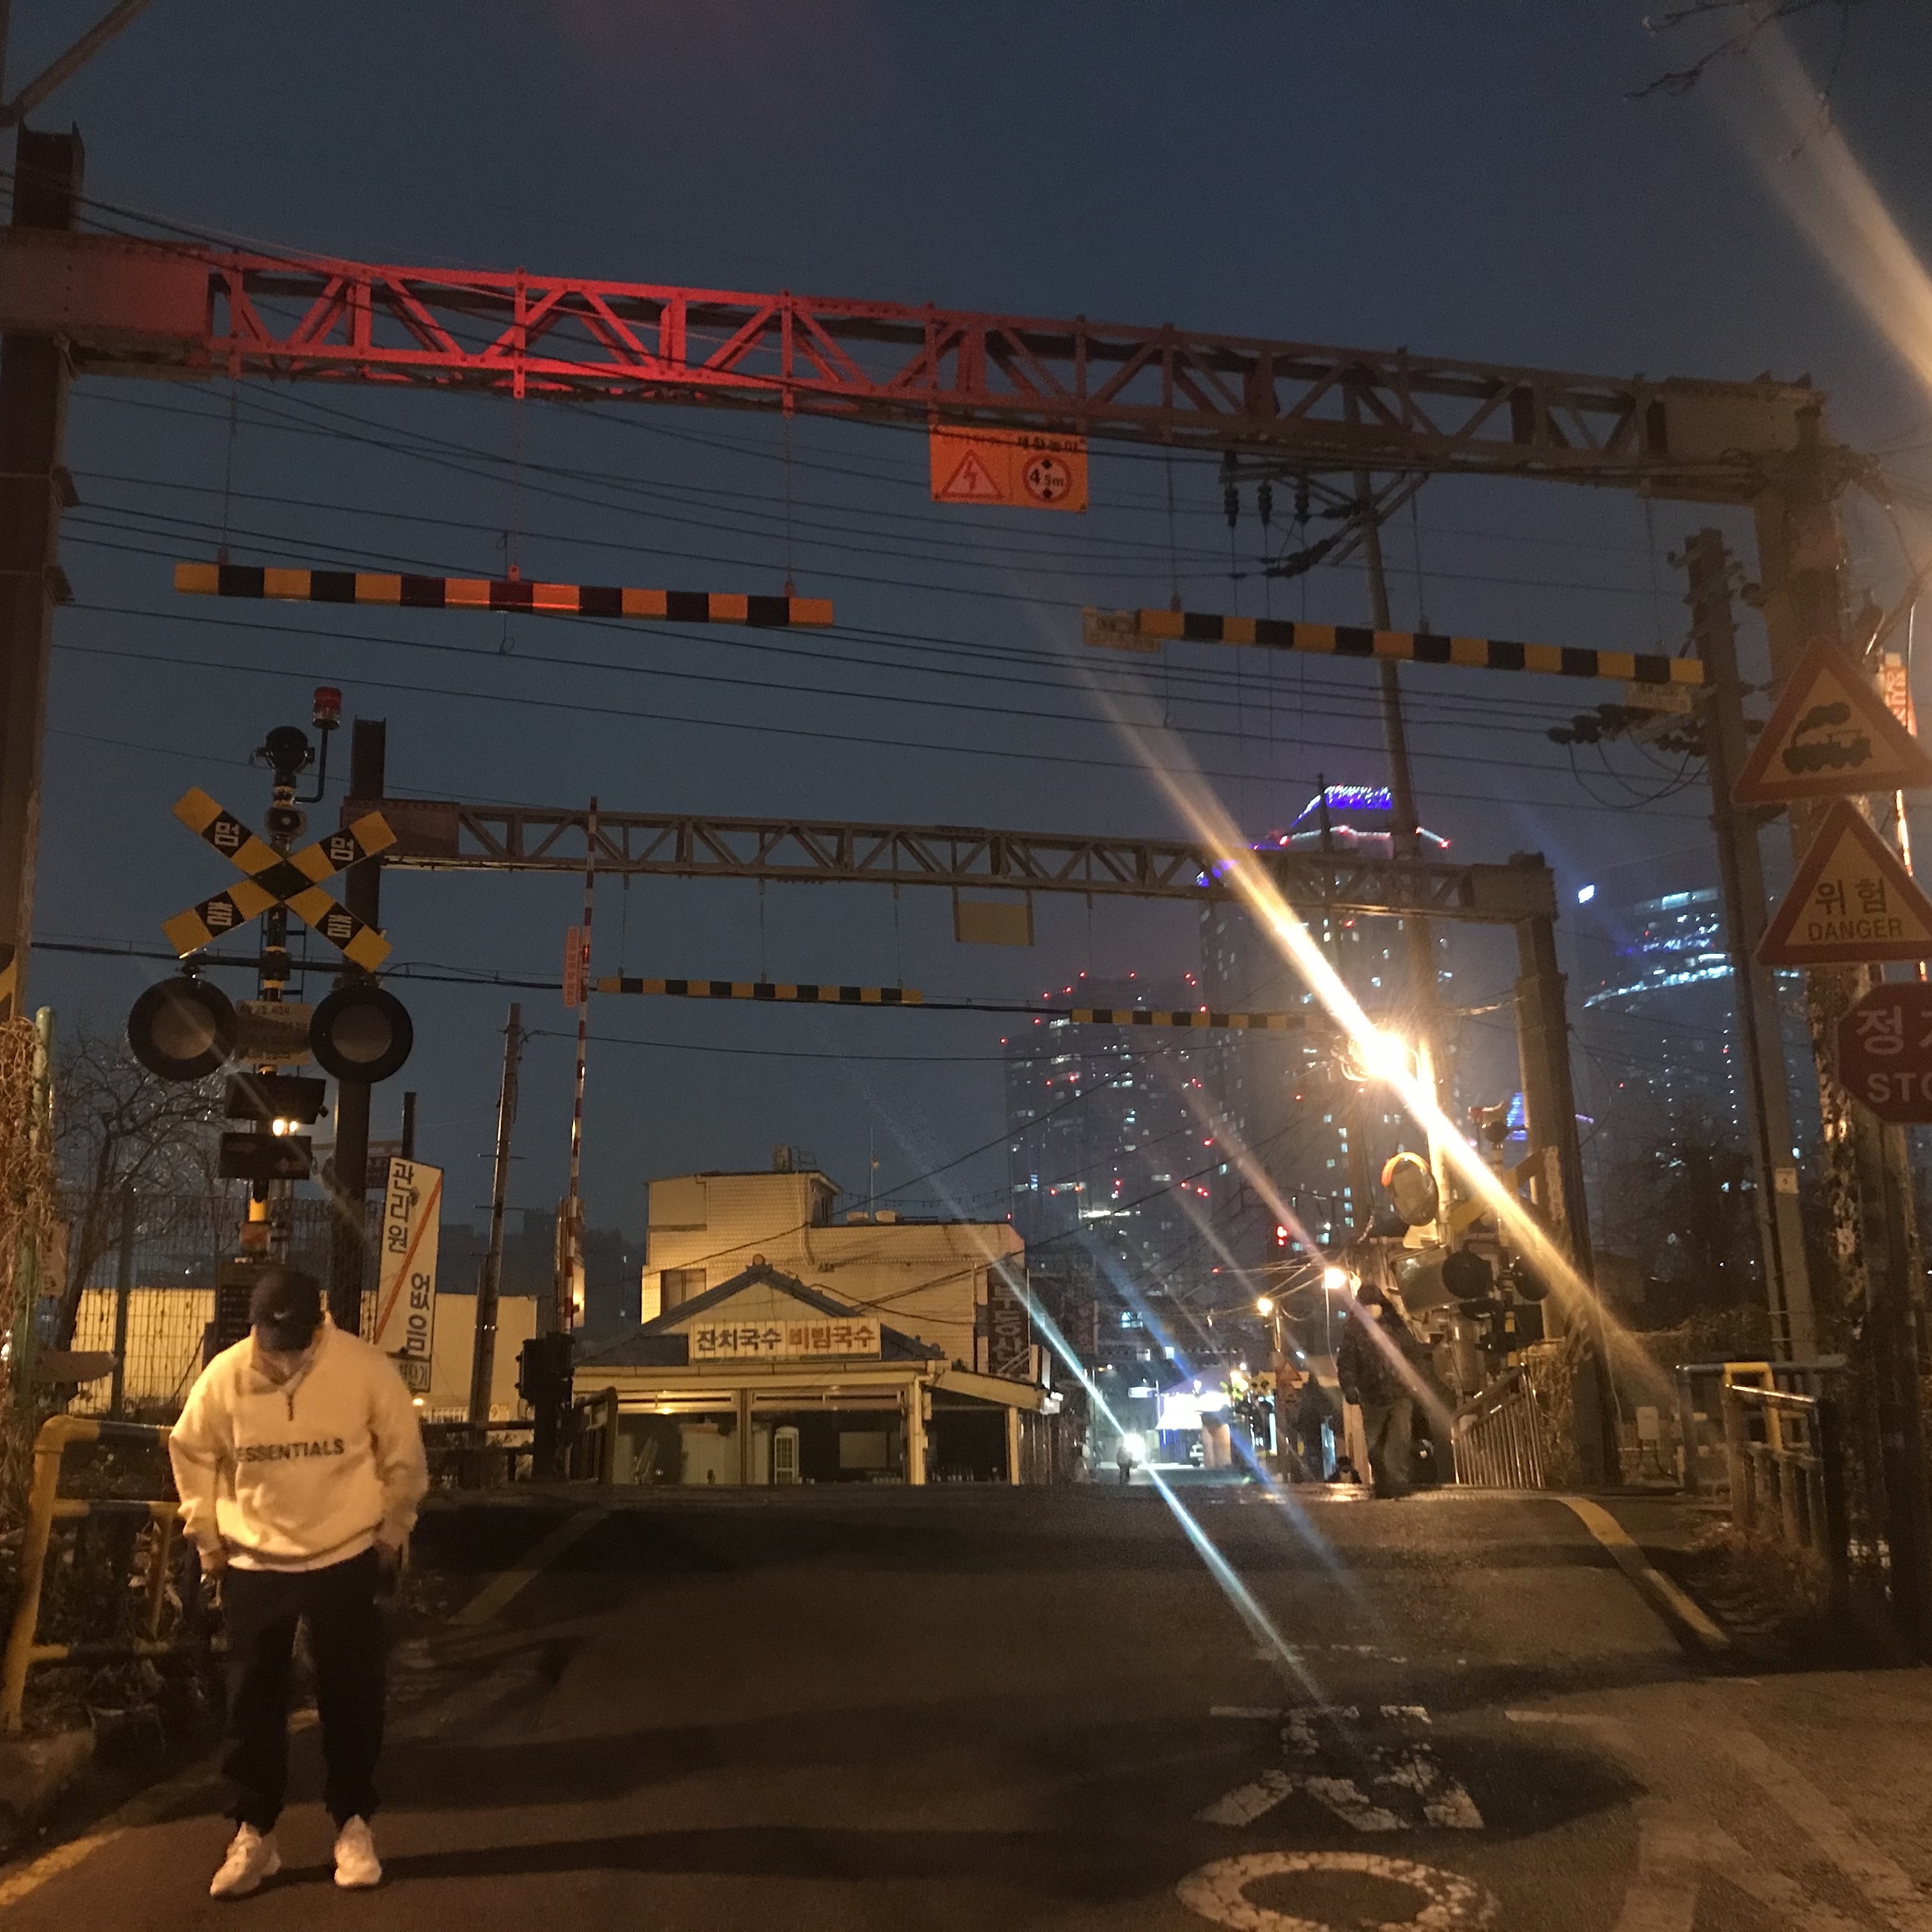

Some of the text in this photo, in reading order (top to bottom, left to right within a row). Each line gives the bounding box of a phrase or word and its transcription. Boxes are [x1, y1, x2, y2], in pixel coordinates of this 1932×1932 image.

[1815, 877, 1887, 915] 위험
[1808, 918, 1903, 941] DANGER
[696, 1324, 875, 1351] 잔치국수 비빔국수
[236, 1438, 345, 1463] ESSENTIALS
